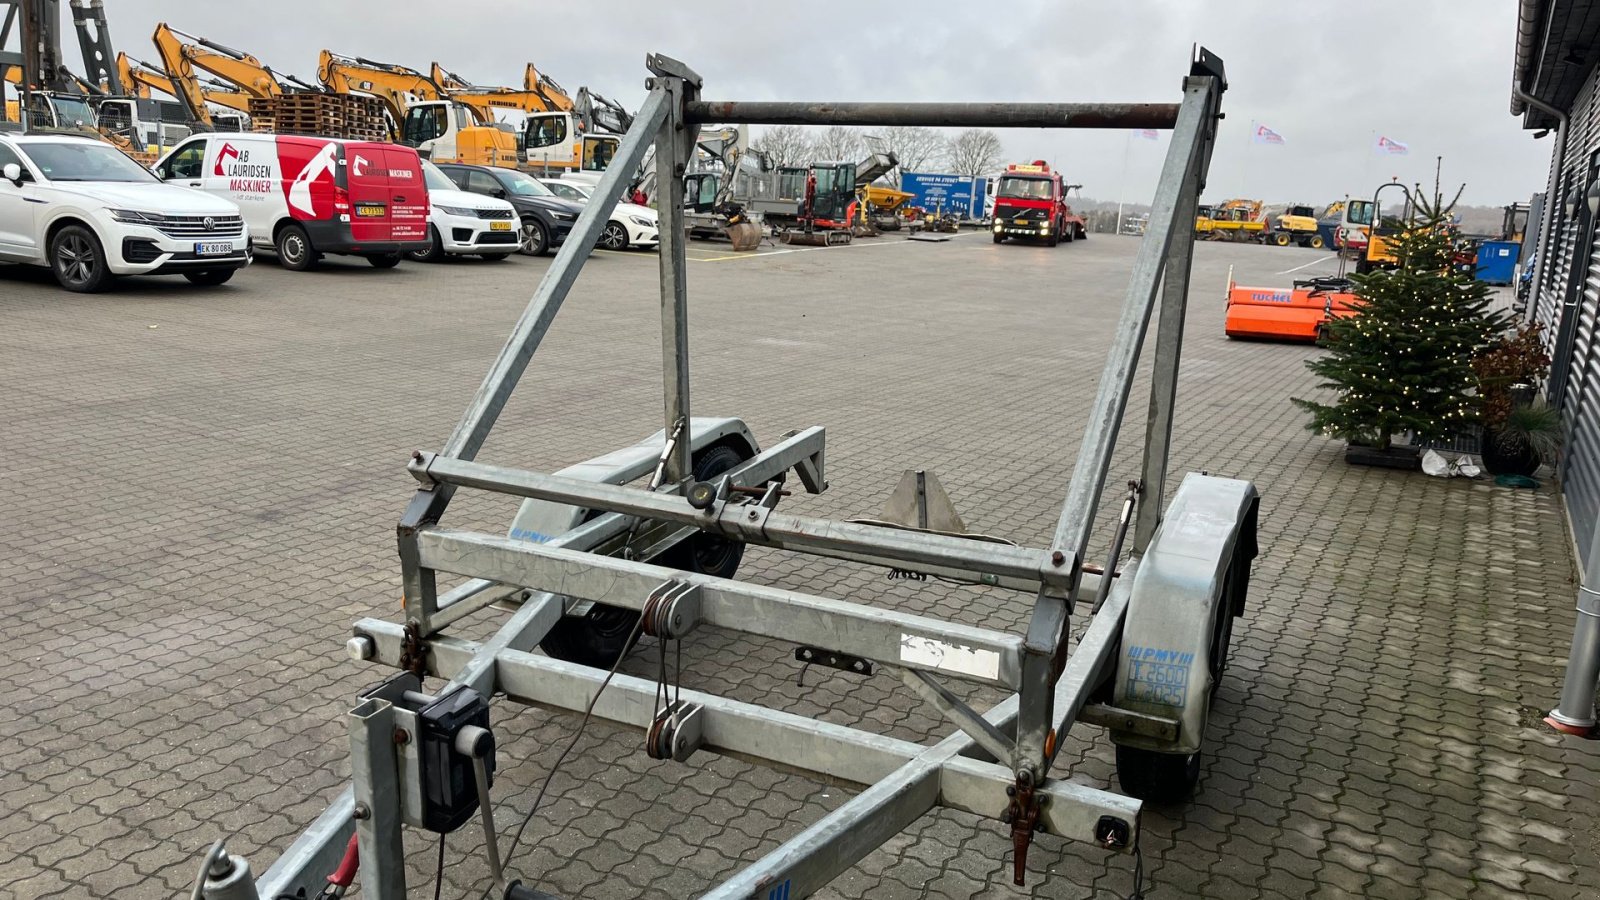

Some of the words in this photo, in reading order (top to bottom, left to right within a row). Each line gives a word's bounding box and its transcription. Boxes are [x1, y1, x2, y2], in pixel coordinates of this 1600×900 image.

[238, 150, 250, 162] AB
[228, 164, 271, 178] LAURIDSEN
[389, 169, 413, 178] MASKINER
[230, 179, 271, 193] MASKINER
[201, 245, 210, 253] EK
[211, 244, 219, 252] 80
